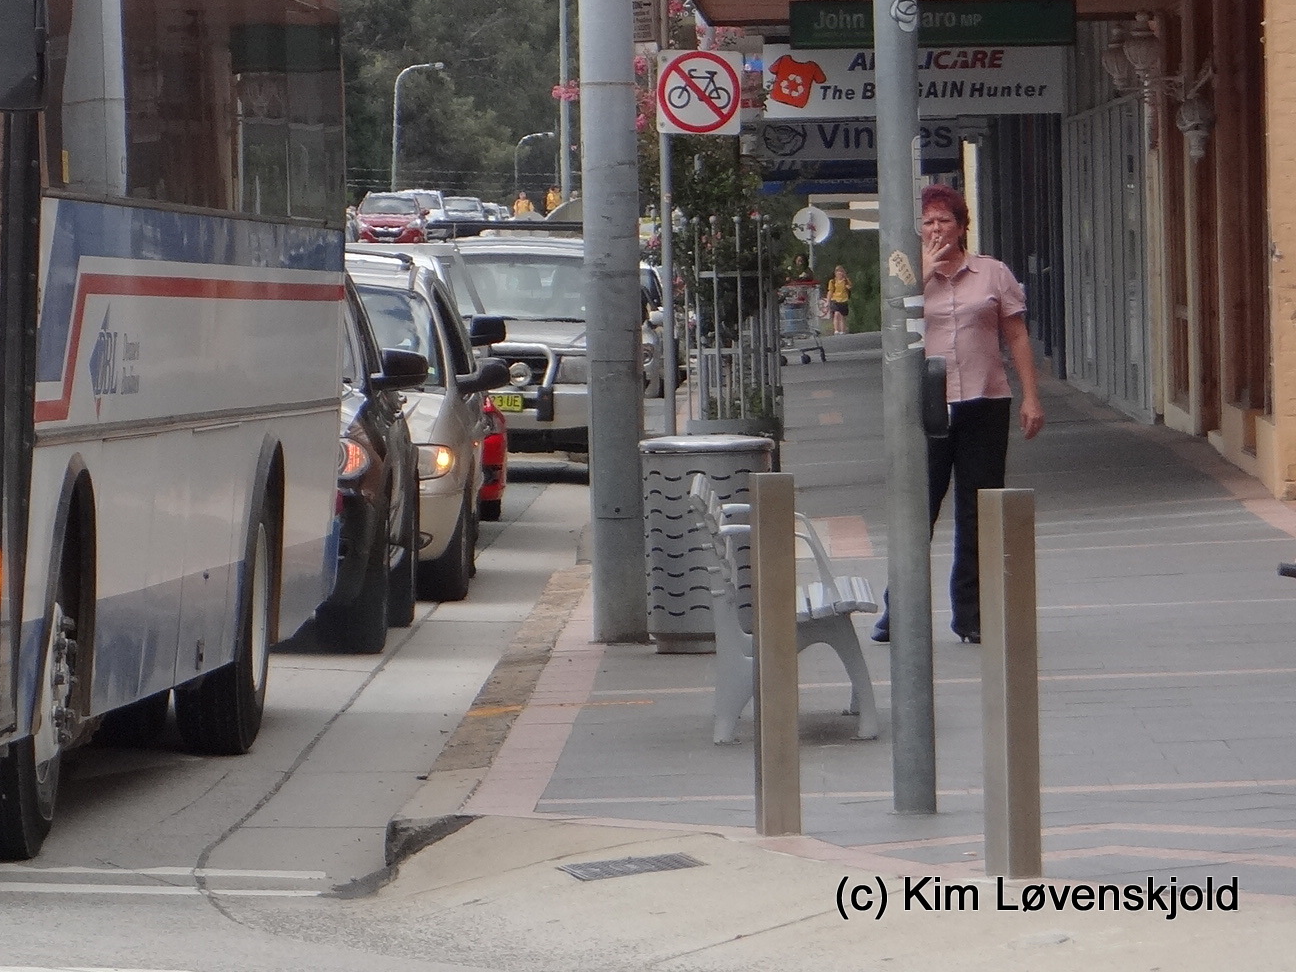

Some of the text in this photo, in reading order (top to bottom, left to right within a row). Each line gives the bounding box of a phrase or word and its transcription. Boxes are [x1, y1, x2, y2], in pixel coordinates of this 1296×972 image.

[814, 9, 865, 29] John
[820, 85, 855, 101] The
[969, 82, 1047, 99] Hunter
[817, 124, 953, 149] Vines
